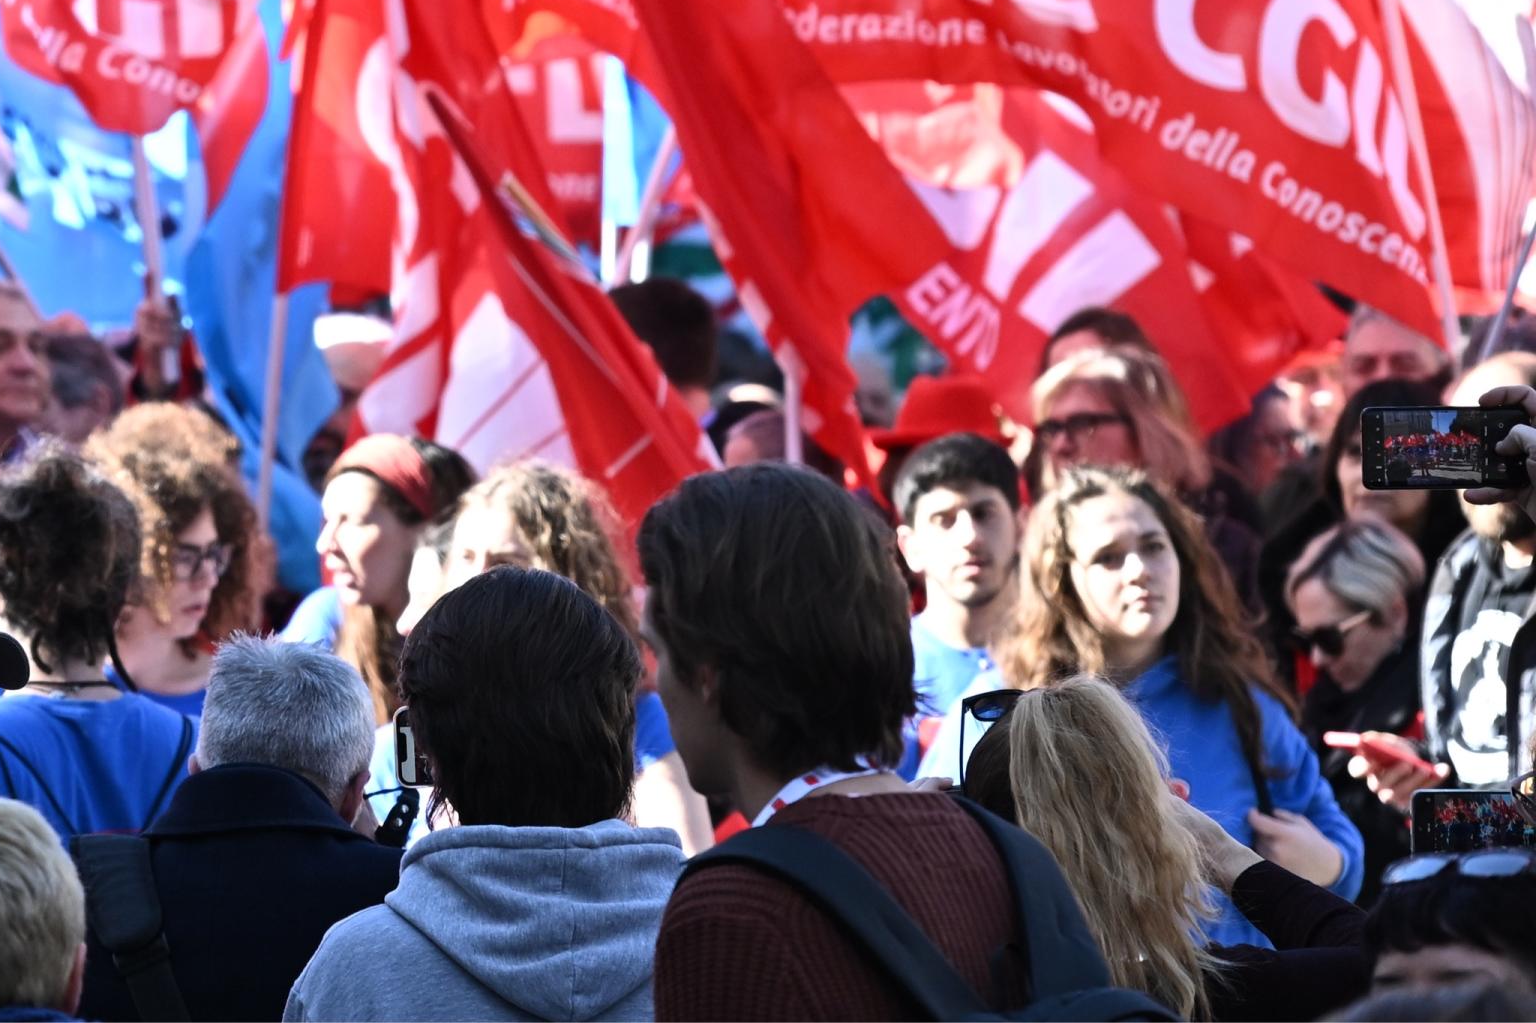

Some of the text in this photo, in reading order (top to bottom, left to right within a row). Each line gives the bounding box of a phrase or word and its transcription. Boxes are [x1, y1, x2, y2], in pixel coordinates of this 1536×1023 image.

[778, 0, 987, 47] derazione
[1160, 113, 1253, 184] della
[1261, 160, 1430, 289] Conoscen
